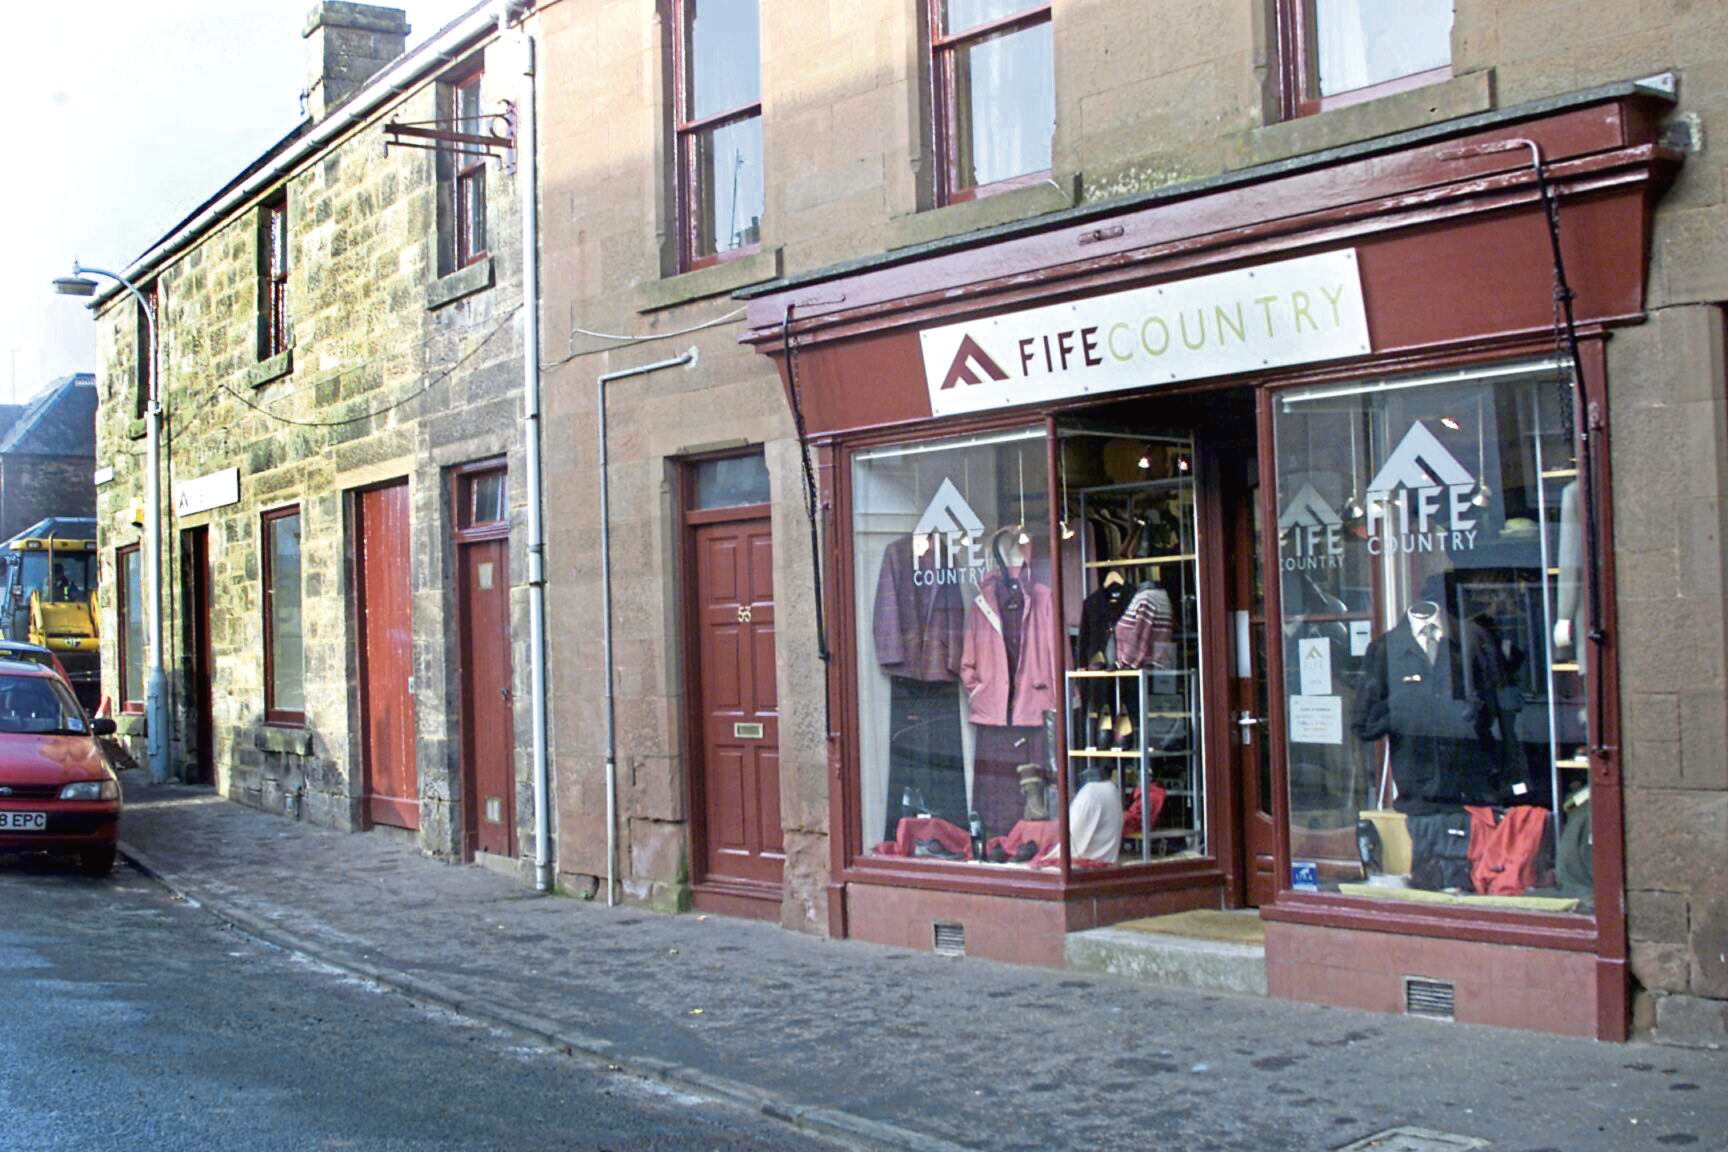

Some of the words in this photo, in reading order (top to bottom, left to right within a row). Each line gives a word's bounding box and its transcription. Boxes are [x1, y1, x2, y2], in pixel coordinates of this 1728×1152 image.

[1366, 485, 1476, 536] FIFE
[912, 530, 984, 570] FIFE
[1367, 531, 1477, 555] COUNTRY
[913, 568, 985, 586] COUNTRY
[12, 814, 44, 827] EPC
